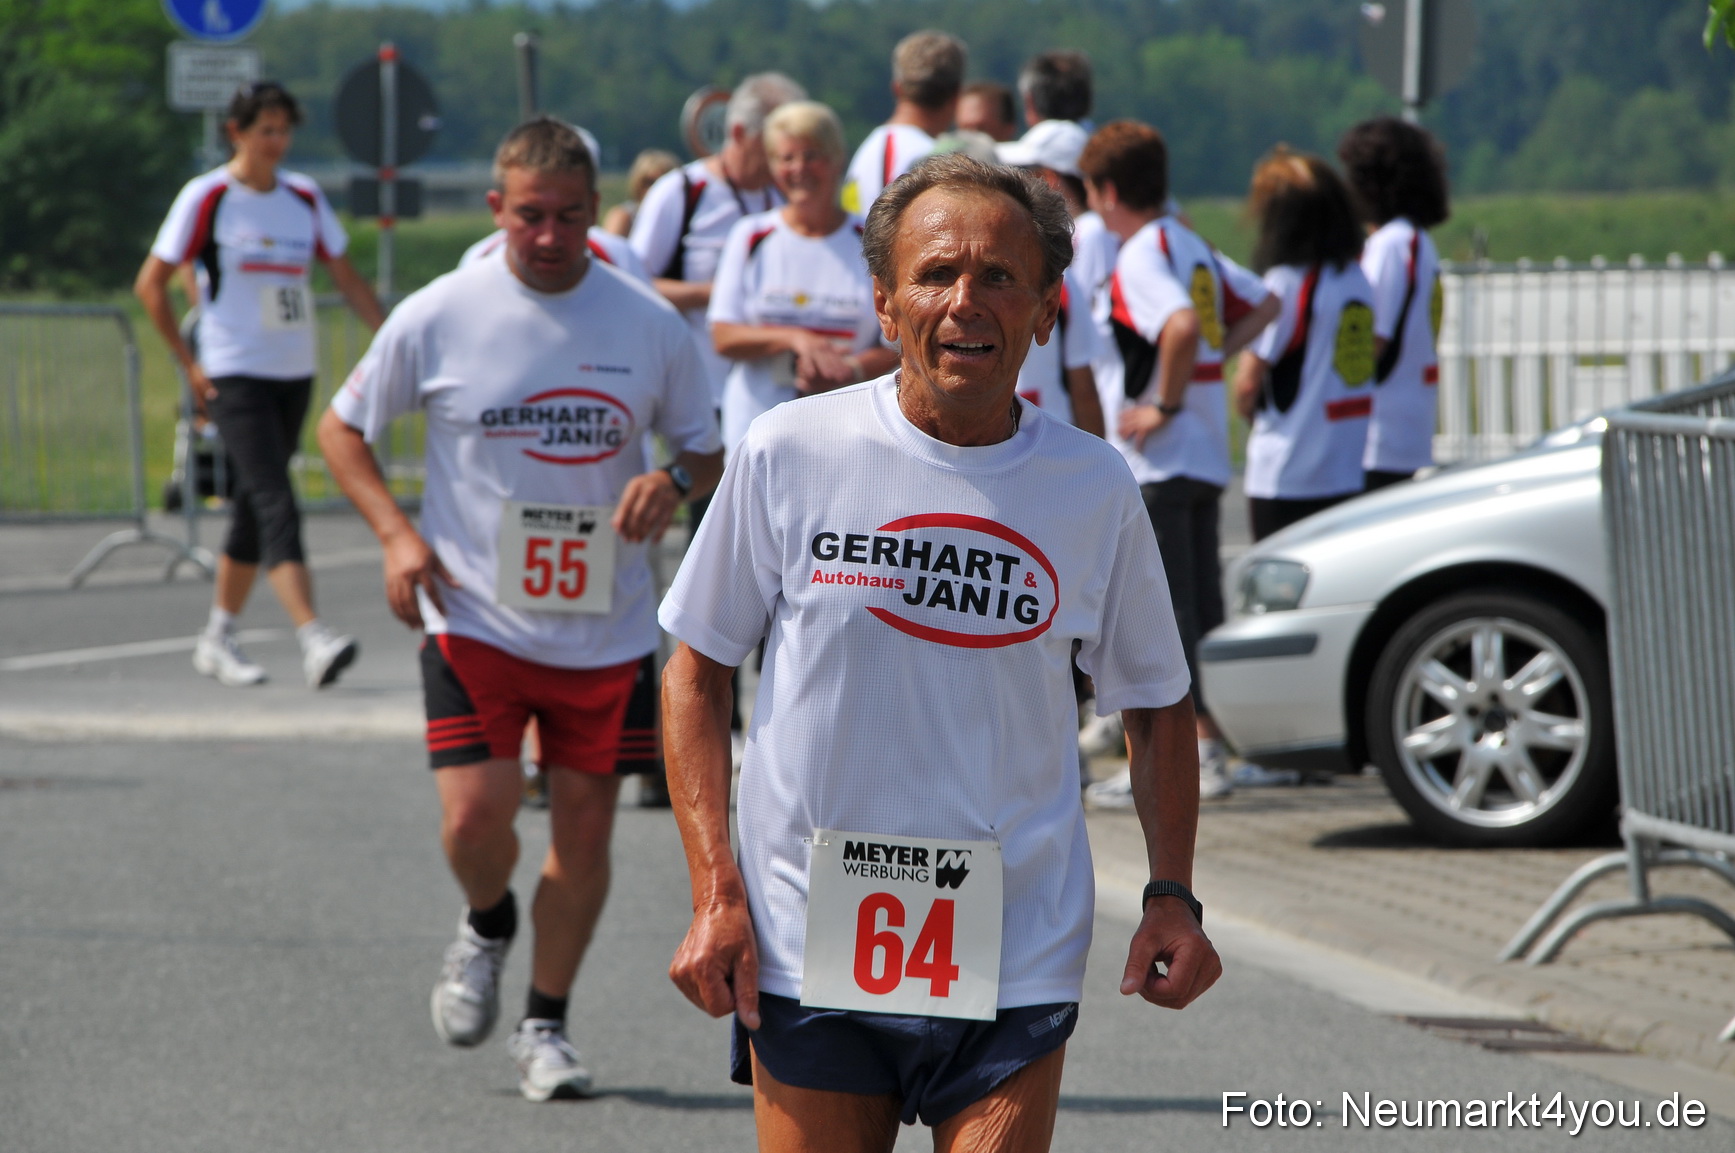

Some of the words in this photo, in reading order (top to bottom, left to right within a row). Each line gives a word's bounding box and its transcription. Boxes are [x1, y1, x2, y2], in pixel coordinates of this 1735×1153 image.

[480, 406, 608, 427] GERHART
[523, 537, 588, 600] 55
[811, 532, 1021, 585] GERHART
[1023, 571, 1038, 588] &
[811, 569, 905, 590] Autohaus
[902, 576, 1040, 625] JÄNIG
[843, 840, 930, 867] MEYER
[843, 861, 930, 883] WERBUNG
[853, 892, 960, 998] 64
